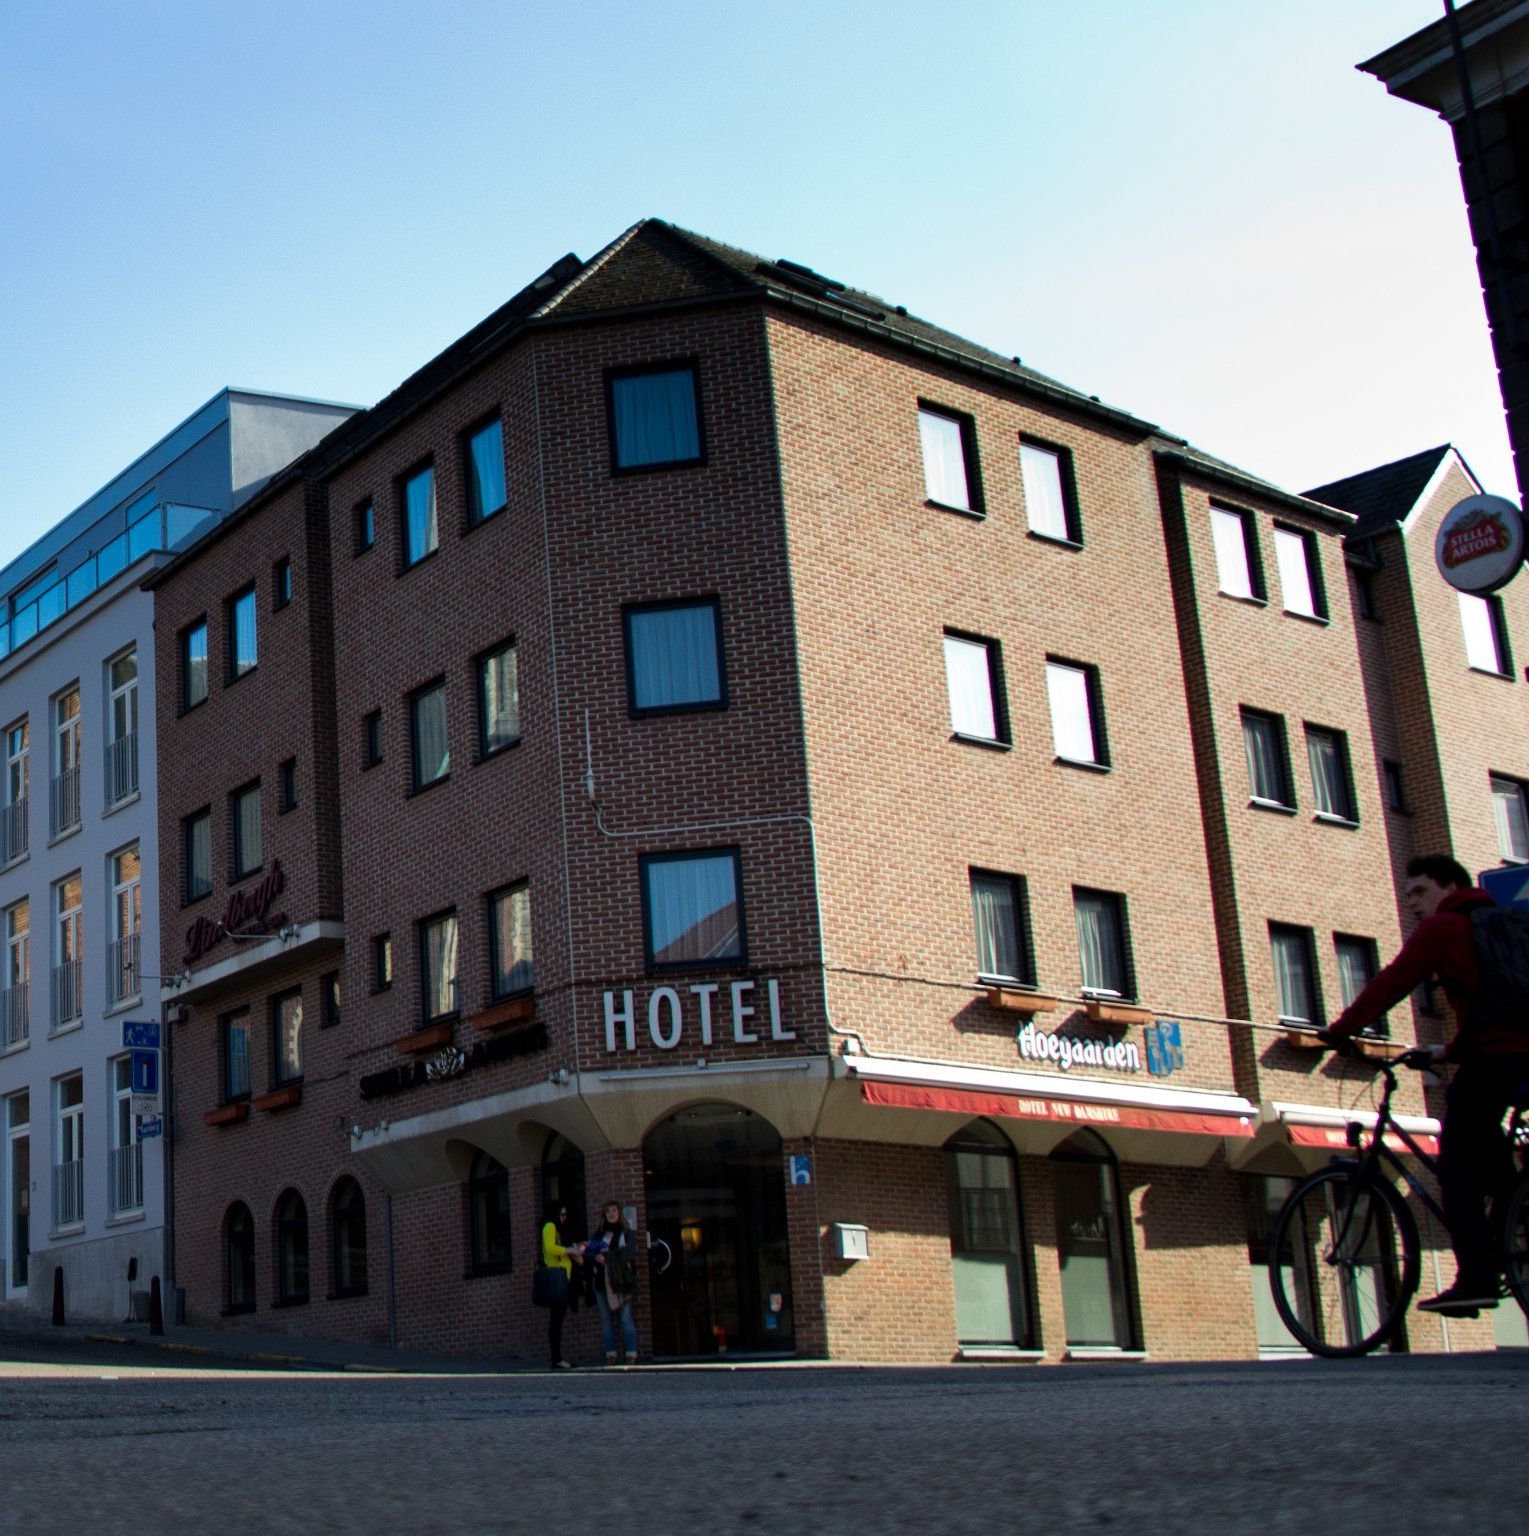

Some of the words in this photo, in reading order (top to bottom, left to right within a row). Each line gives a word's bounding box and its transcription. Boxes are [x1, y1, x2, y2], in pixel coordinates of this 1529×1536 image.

[1451, 525, 1494, 547] STELLA
[1452, 534, 1498, 559] ARTOIS
[603, 978, 796, 1052] HOTEL
[1018, 1021, 1142, 1071] Hoegaarden
[1018, 1098, 1049, 1115] HOTEL
